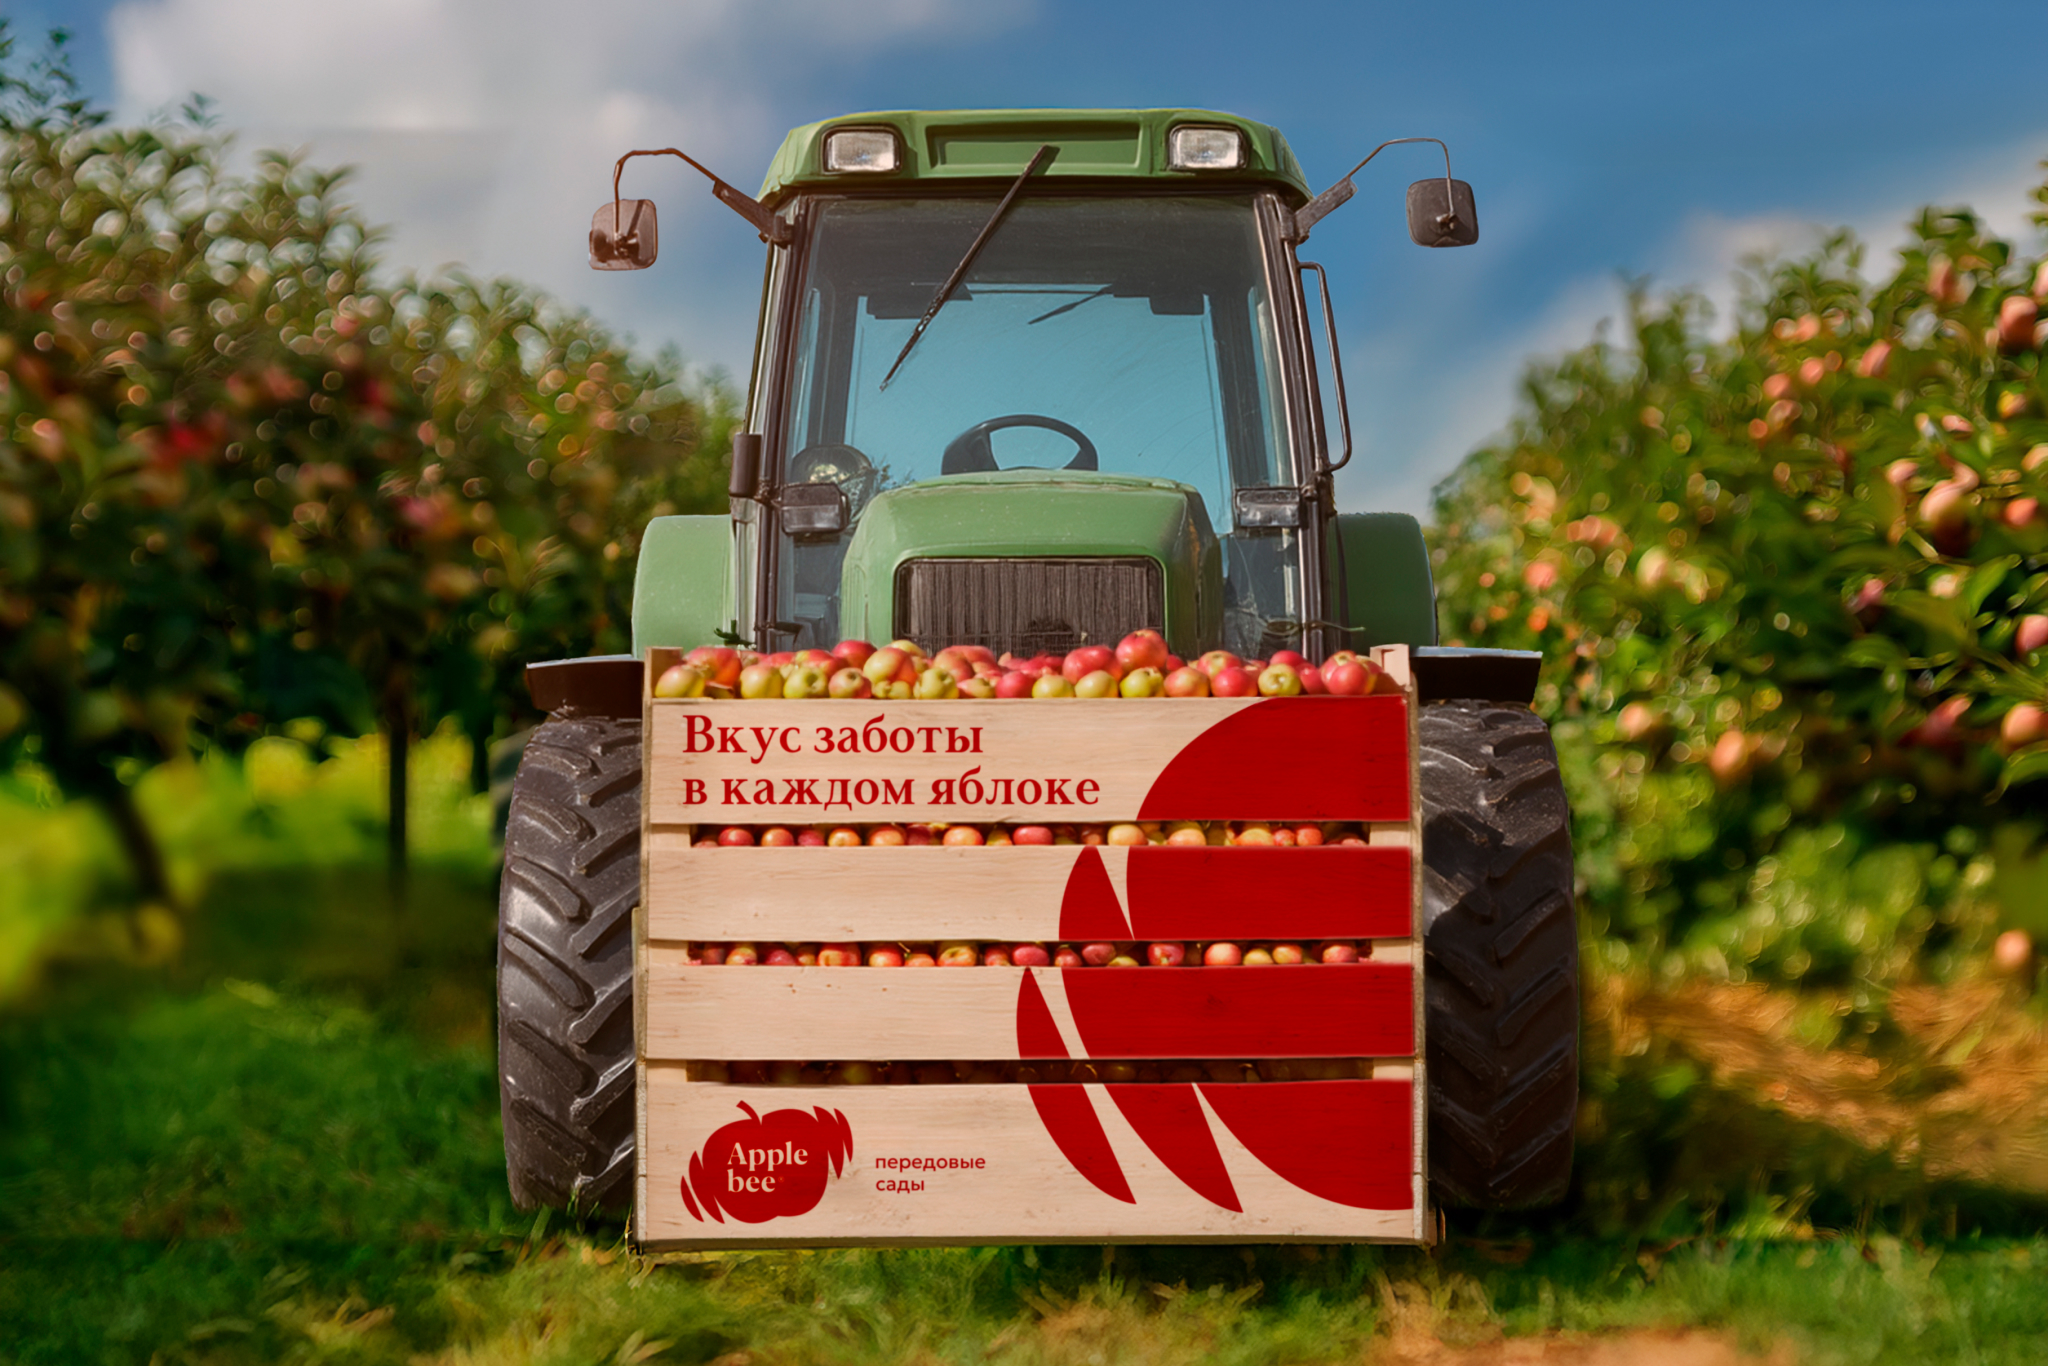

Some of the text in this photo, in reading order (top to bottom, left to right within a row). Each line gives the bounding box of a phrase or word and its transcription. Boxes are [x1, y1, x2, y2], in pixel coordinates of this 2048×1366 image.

[682, 713, 984, 765] Вкус заботы
[682, 764, 1101, 812] в каждом яблоке
[727, 1140, 808, 1172] Apple
[875, 1157, 986, 1173] передовые
[875, 1179, 925, 1194] сады
